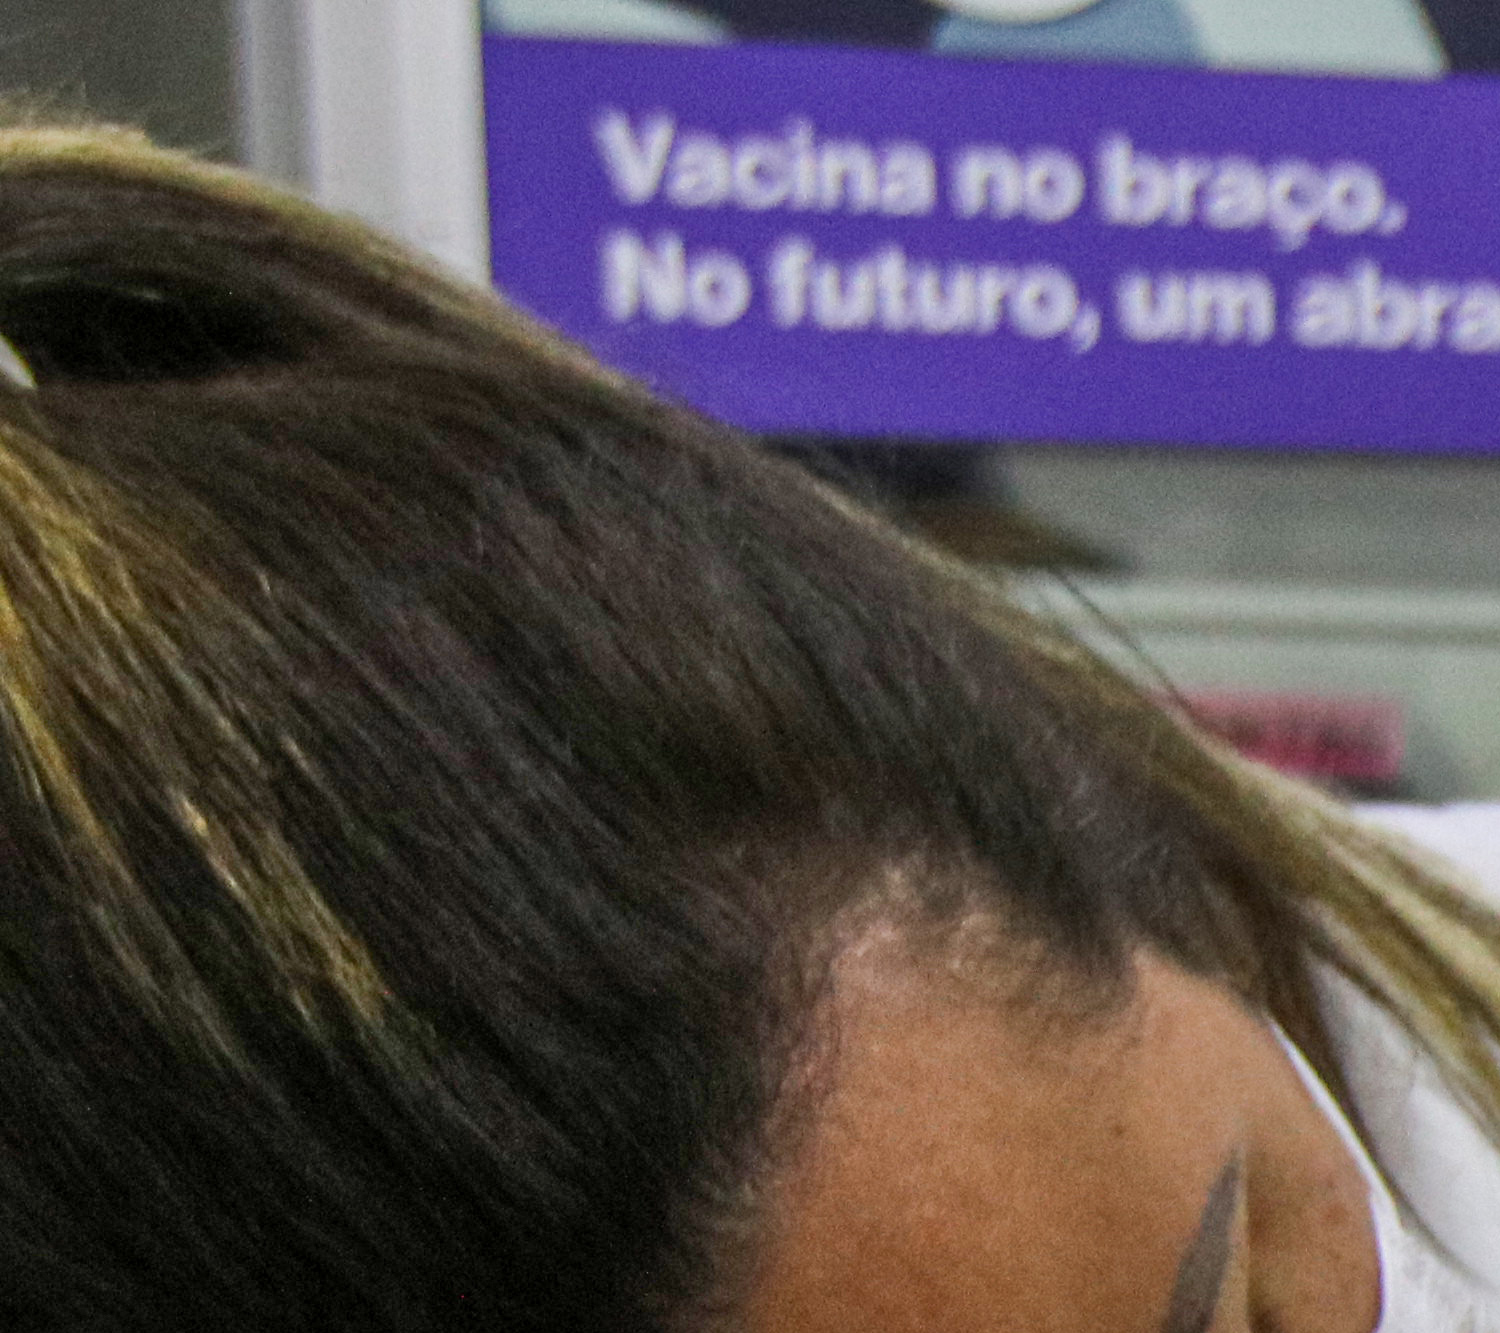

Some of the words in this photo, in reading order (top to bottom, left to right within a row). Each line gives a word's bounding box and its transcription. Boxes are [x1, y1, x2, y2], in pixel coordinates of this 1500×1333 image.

[597, 107, 937, 214] Vacina
[953, 143, 1085, 222] no
[1101, 131, 1408, 251] braço.
[602, 229, 752, 328] No
[766, 232, 1100, 353] futuro,
[1117, 271, 1276, 344] um
